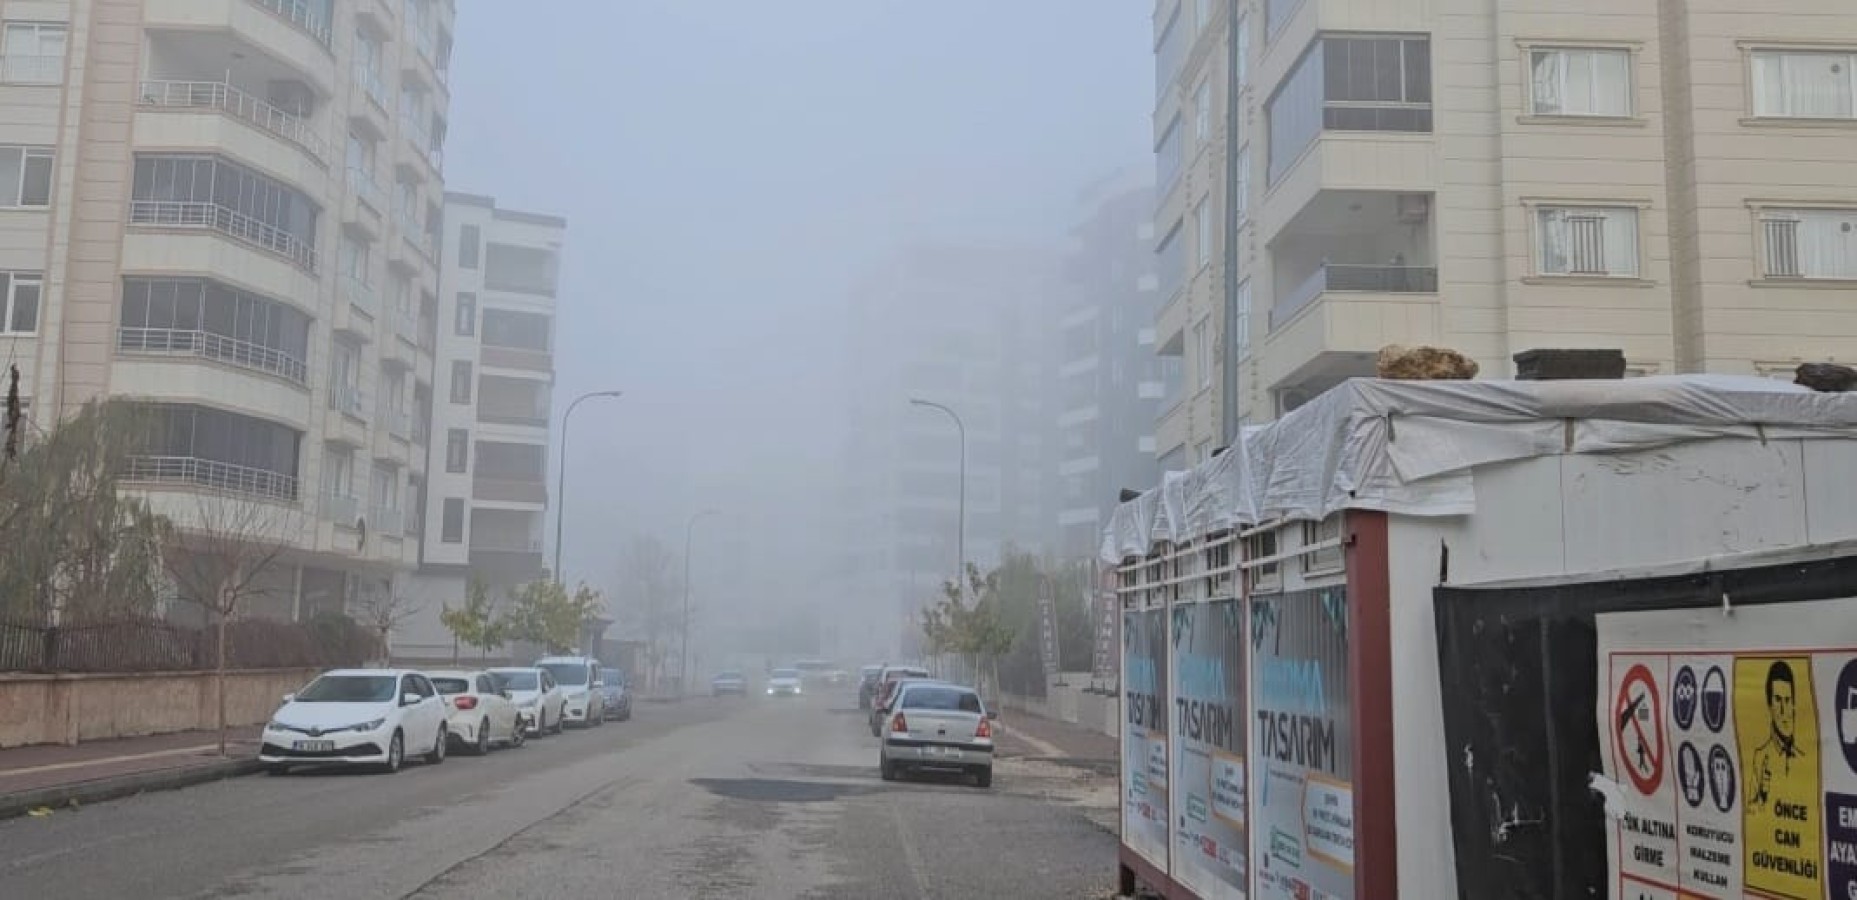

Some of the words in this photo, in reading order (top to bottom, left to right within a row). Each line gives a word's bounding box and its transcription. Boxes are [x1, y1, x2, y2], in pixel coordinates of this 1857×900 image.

[1176, 697, 1231, 752] TASARIM
[1258, 710, 1334, 773] TASARIM
[1774, 799, 1807, 821] ÖNCE
[1641, 818, 1675, 839] ALTINA
[1687, 824, 1734, 844] KORUYUCU
[1774, 828, 1801, 848] CAN
[1634, 842, 1664, 867] GİRME
[1690, 847, 1731, 866] MALZEME
[1752, 850, 1817, 880] GÜVENLİĞİ
